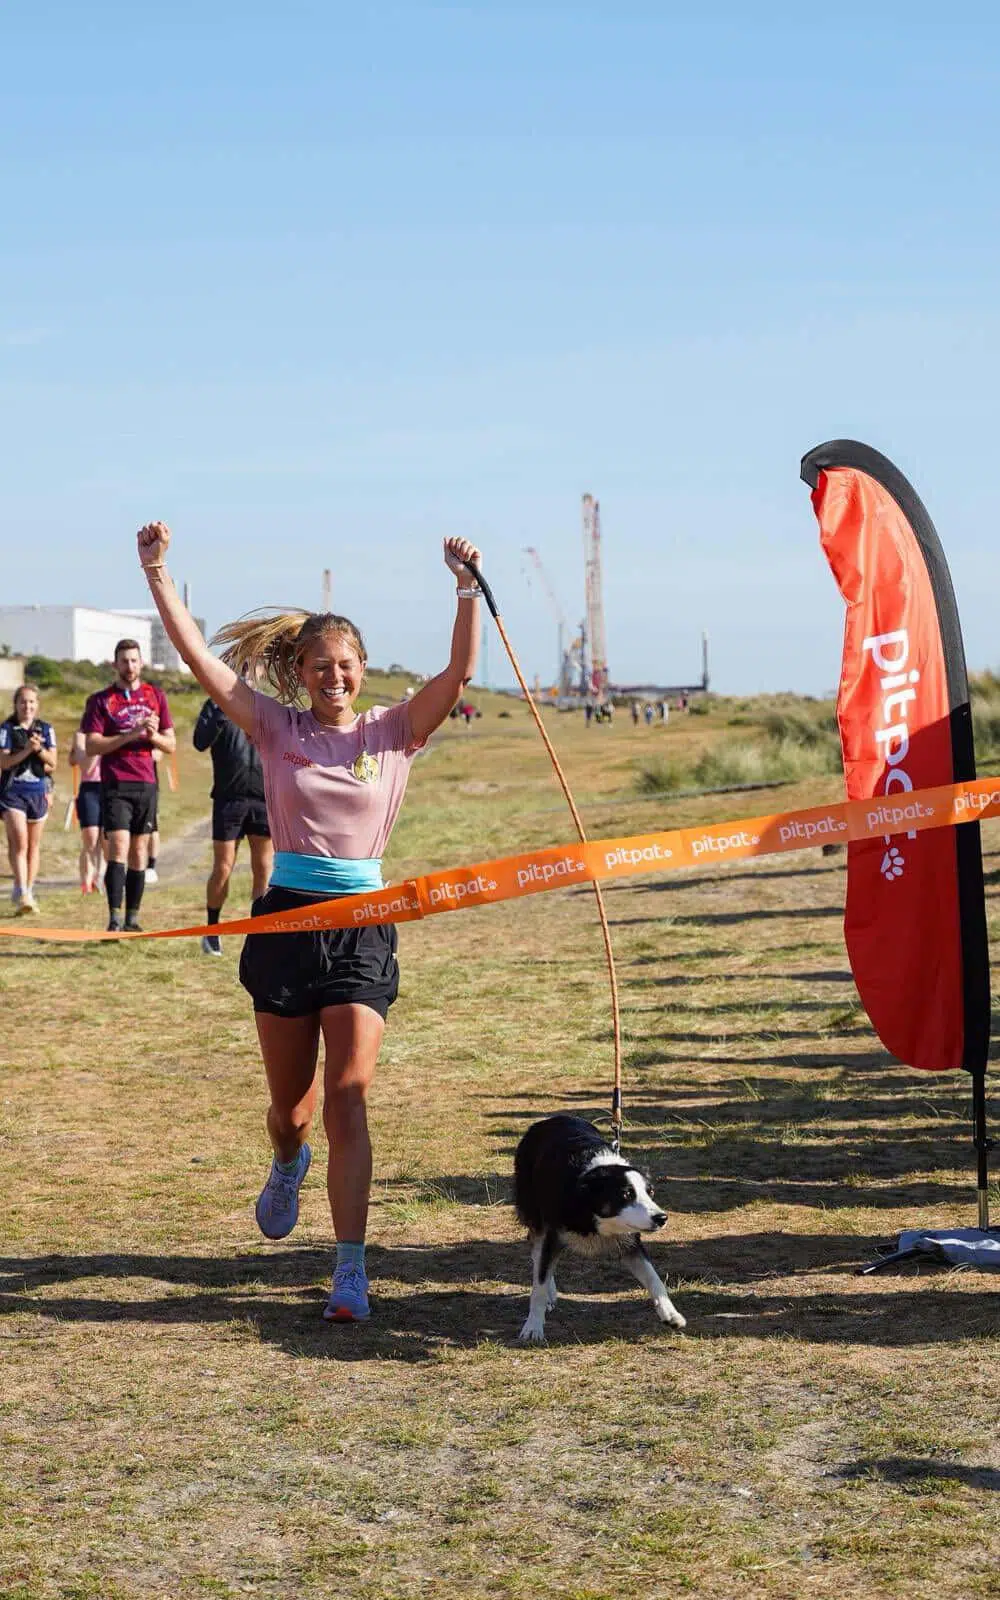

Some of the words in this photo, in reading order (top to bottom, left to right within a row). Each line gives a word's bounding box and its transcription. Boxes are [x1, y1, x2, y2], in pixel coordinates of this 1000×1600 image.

[353, 896, 409, 922] pitpat
[429, 876, 488, 903] pitpat
[517, 857, 576, 887] pitpat
[605, 844, 664, 869] pitpat
[691, 832, 749, 856] pitpat
[779, 817, 837, 842] pitpat
[866, 801, 924, 828] pitpat
